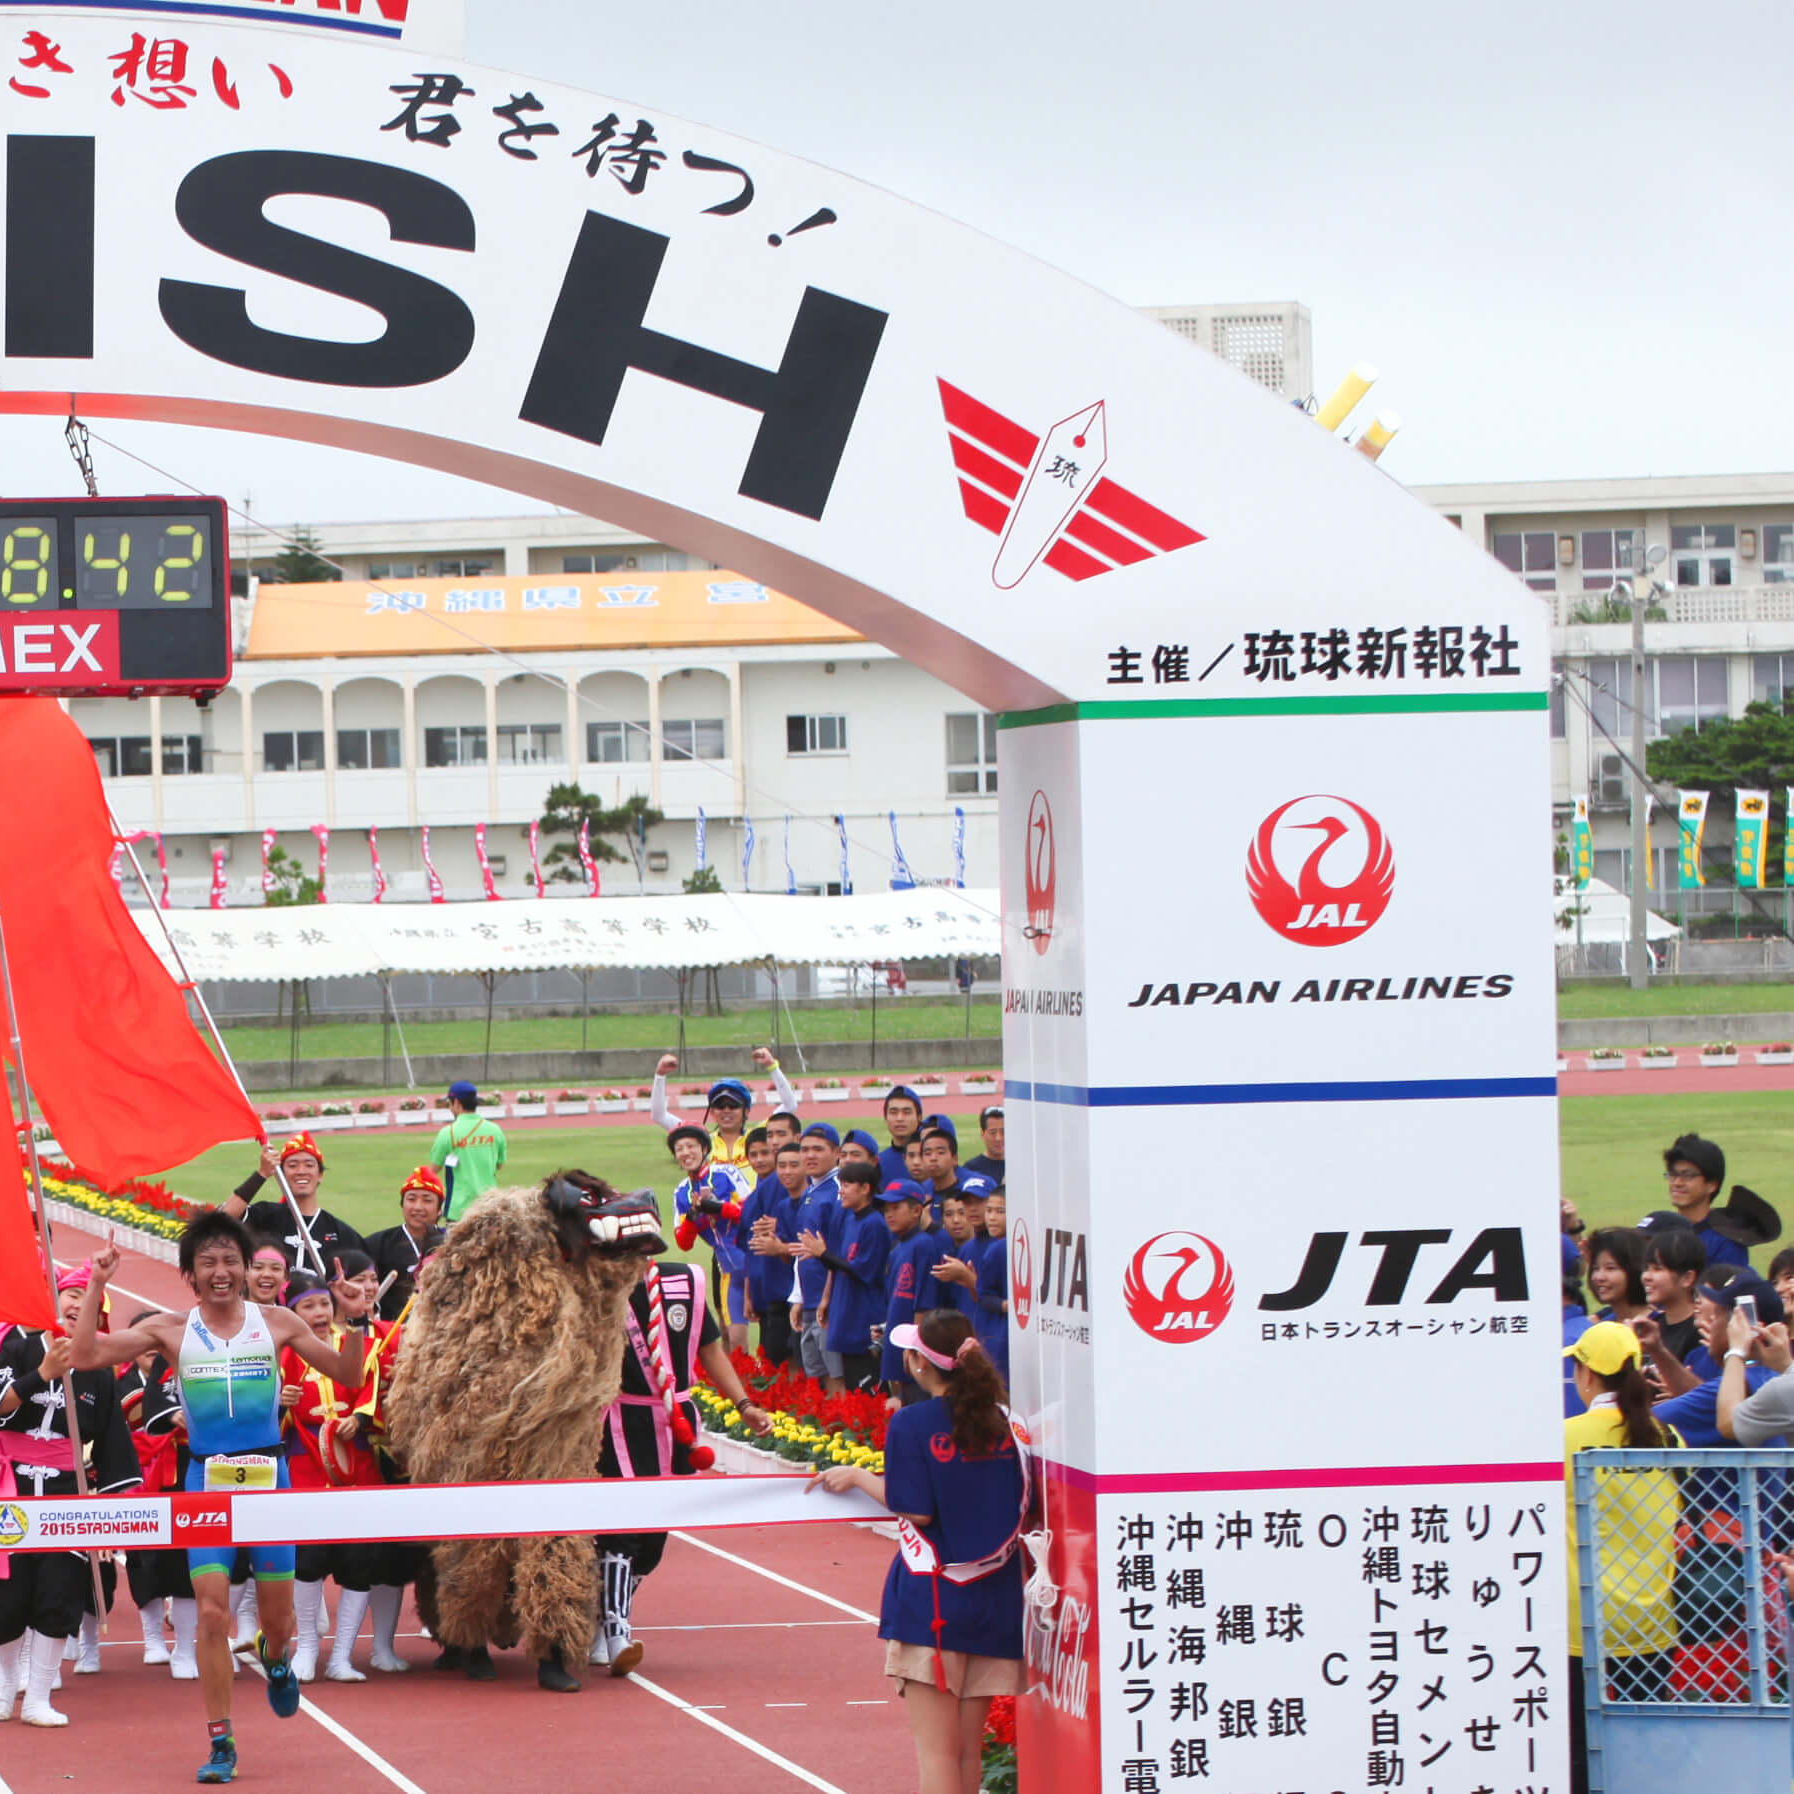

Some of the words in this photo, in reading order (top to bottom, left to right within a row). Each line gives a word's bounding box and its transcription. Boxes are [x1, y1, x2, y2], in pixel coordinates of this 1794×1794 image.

[1045, 455, 1081, 489] 琉
[1286, 902, 1369, 930] JAL
[1035, 991, 1083, 1017] AIRLINES
[1128, 980, 1281, 1008] JAPAN
[1291, 974, 1515, 1003] AIRLINES
[1036, 1228, 1088, 1313] JTA
[1258, 1227, 1531, 1312] JTA
[1153, 1309, 1215, 1332] JAL
[1261, 1314, 1531, 1342] 日本トランスオーシャン航空
[234, 1467, 247, 1484] 3
[39, 1510, 159, 1522] CONGRATULATIONS
[39, 1524, 76, 1536] 2015
[77, 1521, 159, 1535] STRONGMAN
[193, 1512, 229, 1524] JTA
[1215, 1510, 1257, 1794] 沖縄銀
[1264, 1509, 1307, 1794] 琉球銀
[1318, 1513, 1350, 1794] OC
[1362, 1505, 1404, 1794] 沖縄トヨタ自動
[1410, 1504, 1453, 1794] 琉球セメン
[1509, 1502, 1550, 1794] パワースポー
